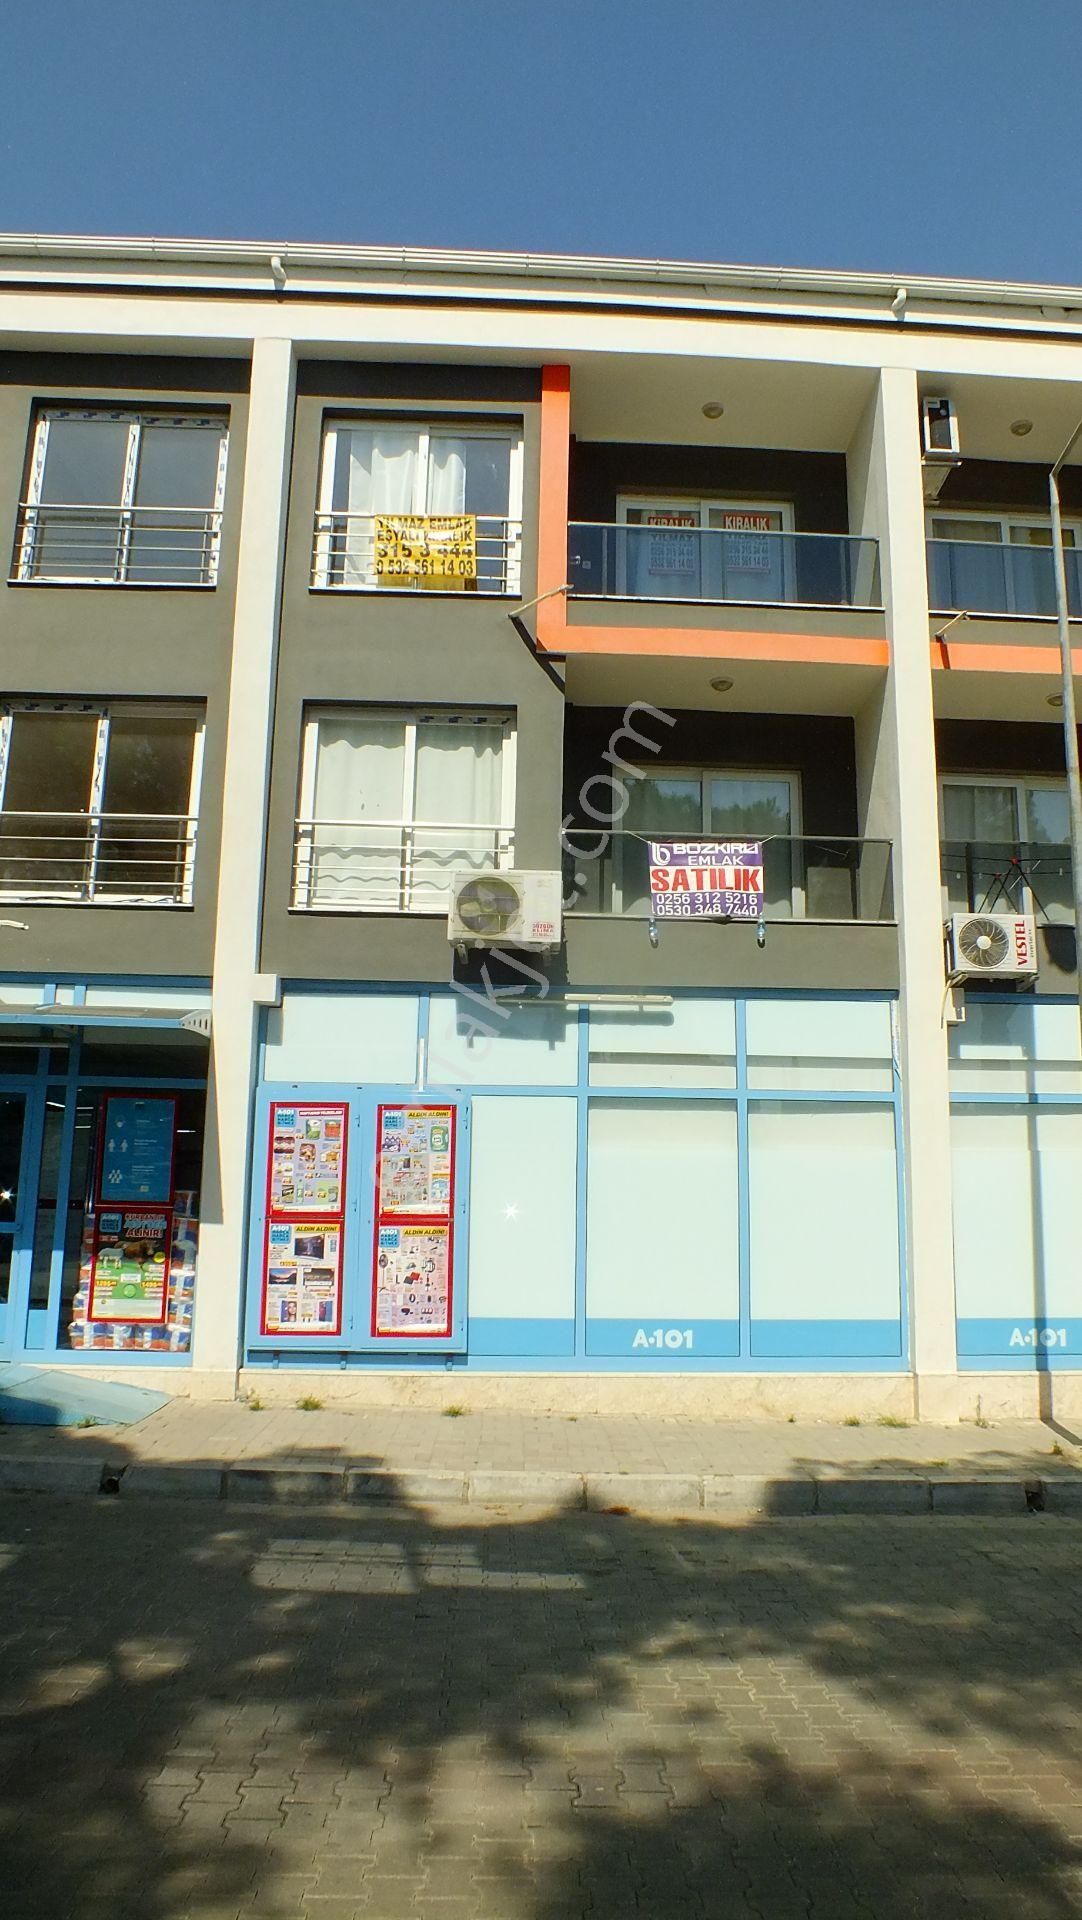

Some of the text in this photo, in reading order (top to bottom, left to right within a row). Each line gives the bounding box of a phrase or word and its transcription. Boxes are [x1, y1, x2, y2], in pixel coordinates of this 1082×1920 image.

[441, 559, 454, 575] 14
[459, 560, 473, 575] 03
[687, 856, 744, 866] EMLAK
[651, 868, 760, 892] SATILIK
[656, 892, 757, 905] 0256 312 5216
[656, 903, 757, 915] 0530 348 7440
[1014, 920, 1028, 965] VESTEL
